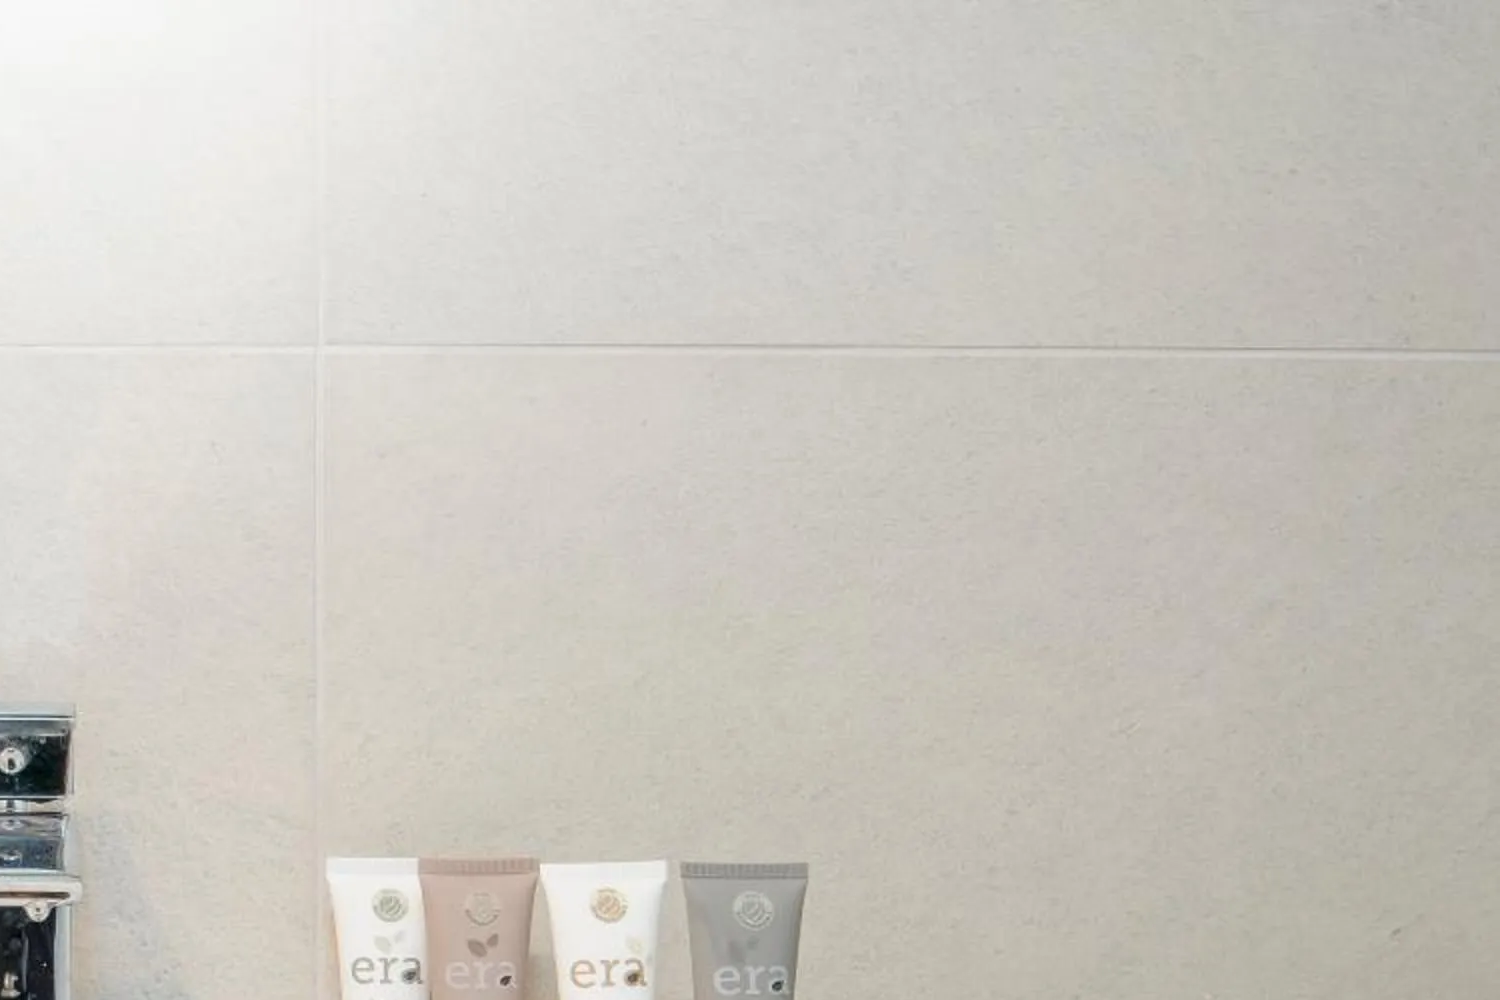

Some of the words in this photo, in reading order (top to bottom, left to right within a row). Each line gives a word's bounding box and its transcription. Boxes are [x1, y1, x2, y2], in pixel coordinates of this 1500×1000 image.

[351, 955, 423, 985] era
[445, 960, 517, 989] era
[569, 957, 648, 988] era
[713, 964, 791, 995] era
